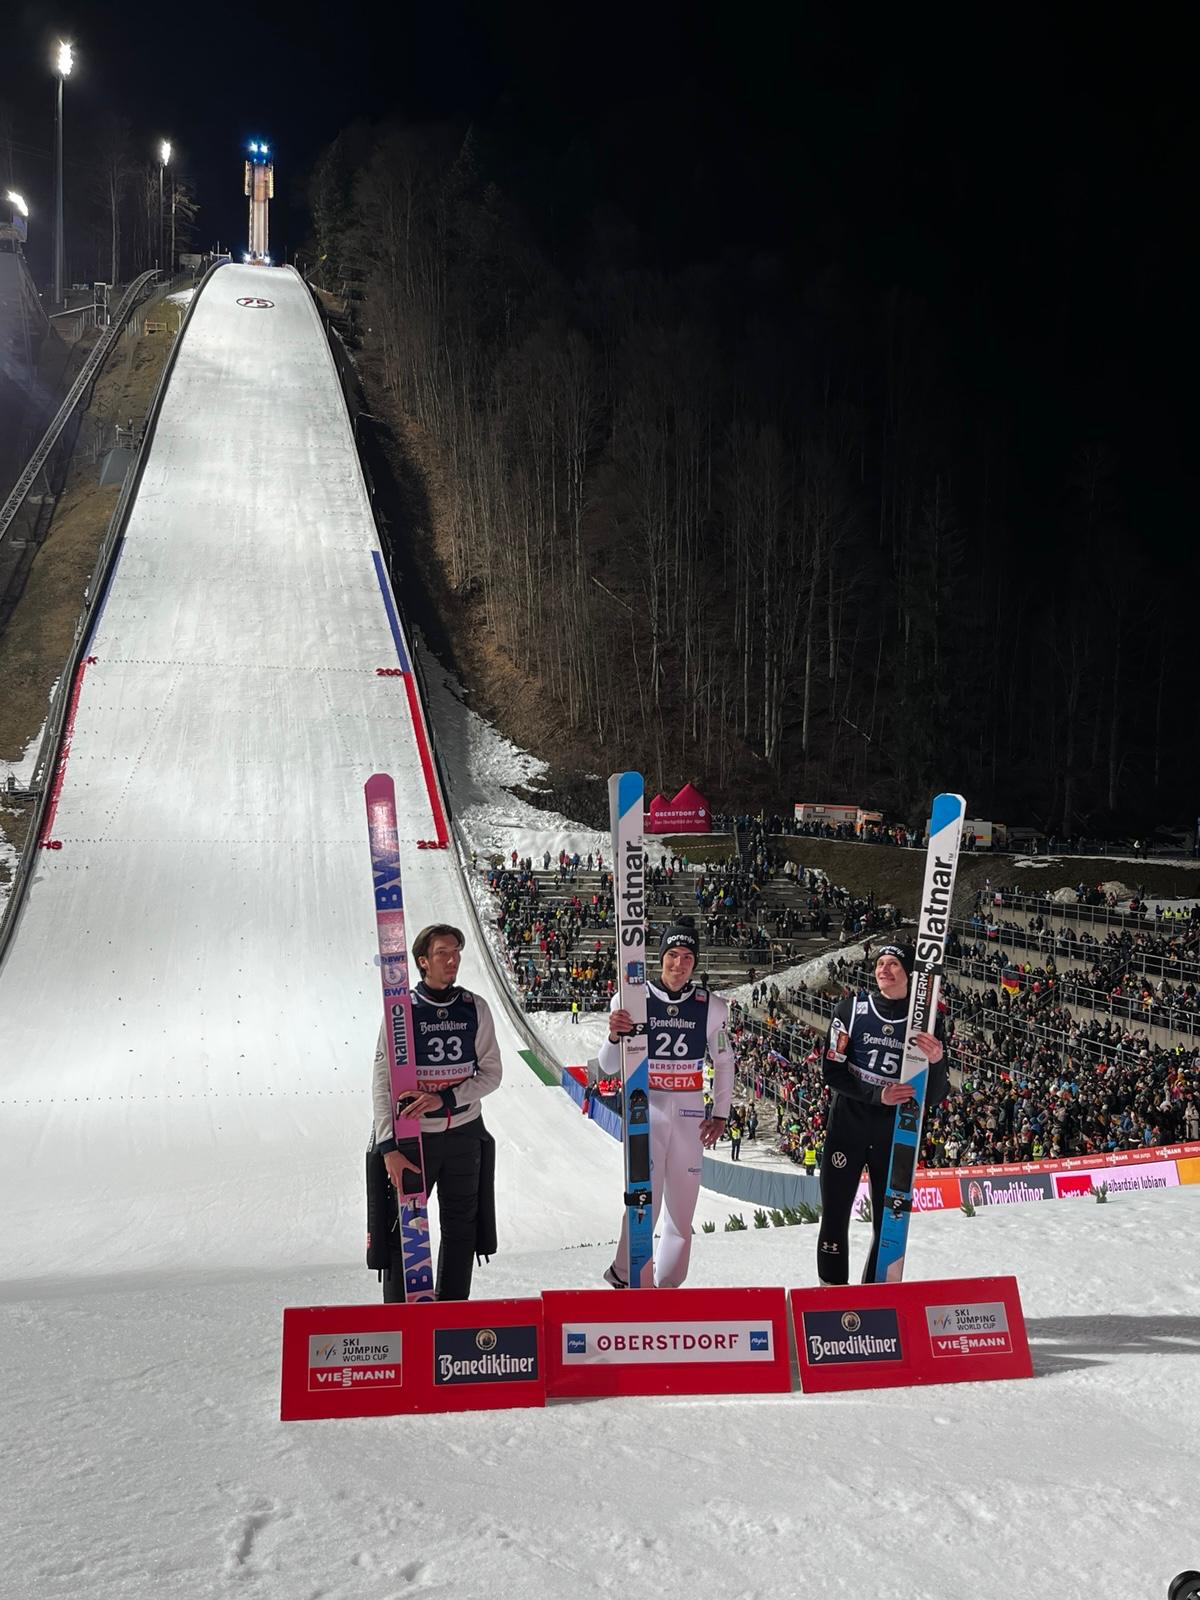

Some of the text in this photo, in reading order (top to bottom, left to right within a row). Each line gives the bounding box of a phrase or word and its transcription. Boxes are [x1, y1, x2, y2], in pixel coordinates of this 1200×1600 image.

[243, 298, 268, 308] 75
[87, 656, 97, 665] K
[376, 668, 402, 676] 200
[39, 840, 63, 850] HS
[416, 840, 448, 850] 235
[622, 840, 643, 947] Slatnar
[918, 856, 953, 963] Slatnar
[384, 987, 408, 997] BWT
[420, 1020, 468, 1035] Benediktiner
[650, 1016, 696, 1030] Benediktiner
[392, 1004, 408, 1066] Nammo
[427, 1036, 463, 1062] 33
[655, 1032, 689, 1057] 26
[866, 1049, 900, 1075] 15
[416, 1066, 471, 1077] OBERSTDORF
[954, 1308, 970, 1317] SKI
[956, 1314, 996, 1324] JUMPING
[343, 1338, 360, 1347] SKI
[597, 1333, 739, 1352] OBERSTDORF
[809, 1335, 897, 1361] Benediktiner
[938, 1335, 1006, 1353] VIESSMANN
[343, 1345, 390, 1355] JUMPING
[343, 1353, 388, 1362] WORLD CUP
[438, 1353, 534, 1381] Benediktiner
[316, 1367, 396, 1387] VIESSMANN
